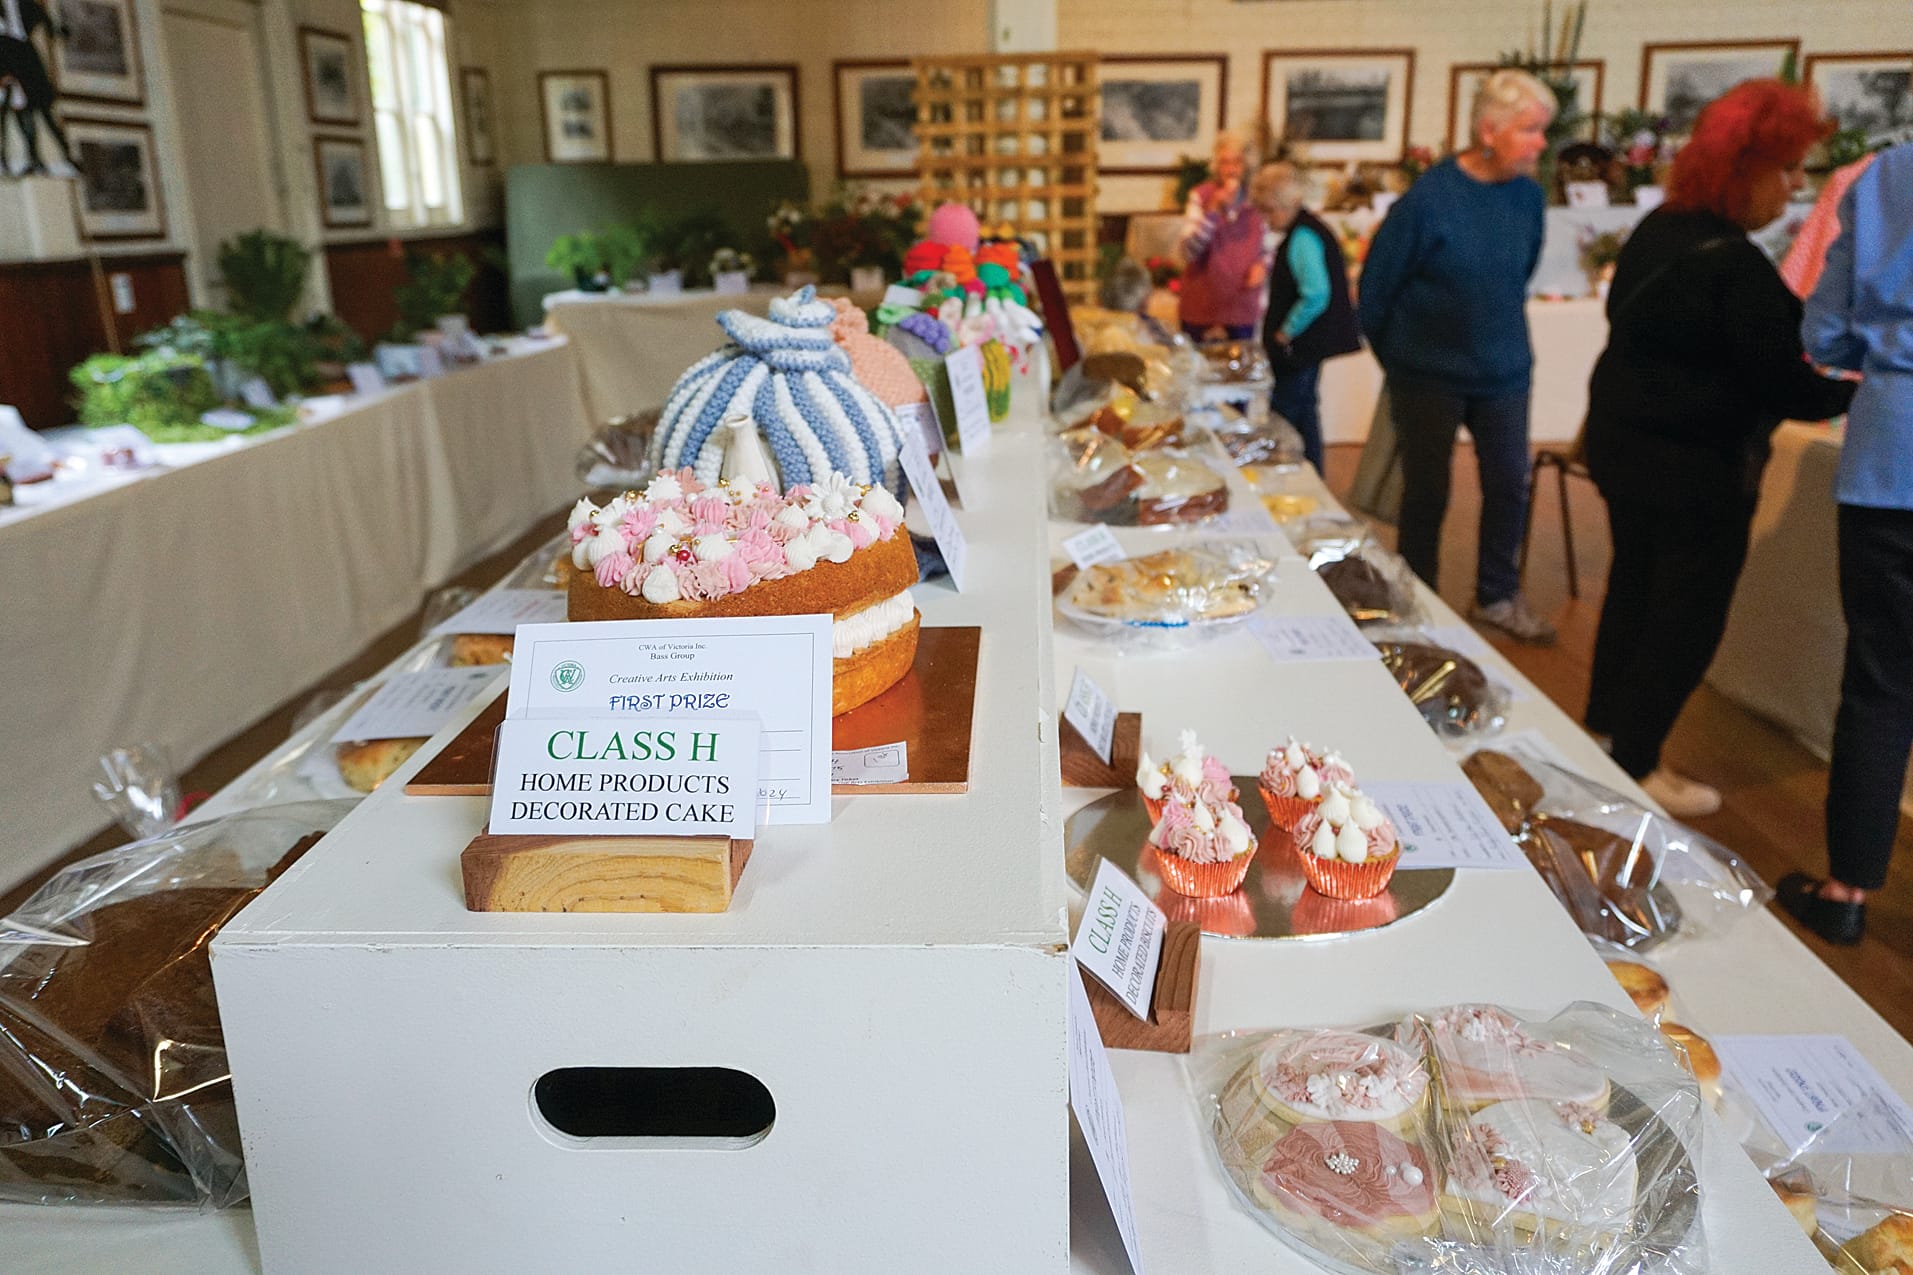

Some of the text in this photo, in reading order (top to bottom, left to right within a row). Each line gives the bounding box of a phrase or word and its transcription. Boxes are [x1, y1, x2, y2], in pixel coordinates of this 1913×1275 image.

[650, 652, 695, 661] Bass Group
[667, 642, 694, 650] Victoria
[609, 671, 734, 684] Creative Arts Exhibition
[609, 693, 731, 712] FIRST PRIZE
[547, 730, 721, 762] CLASS H
[519, 772, 730, 795] HOME PRODUCTS
[510, 801, 735, 823] DECORATED CAKE
[1088, 885, 1123, 955] CLASS H
[1111, 900, 1142, 980] HOME PRODUCTS
[1125, 944, 1149, 1006] DECORATED
